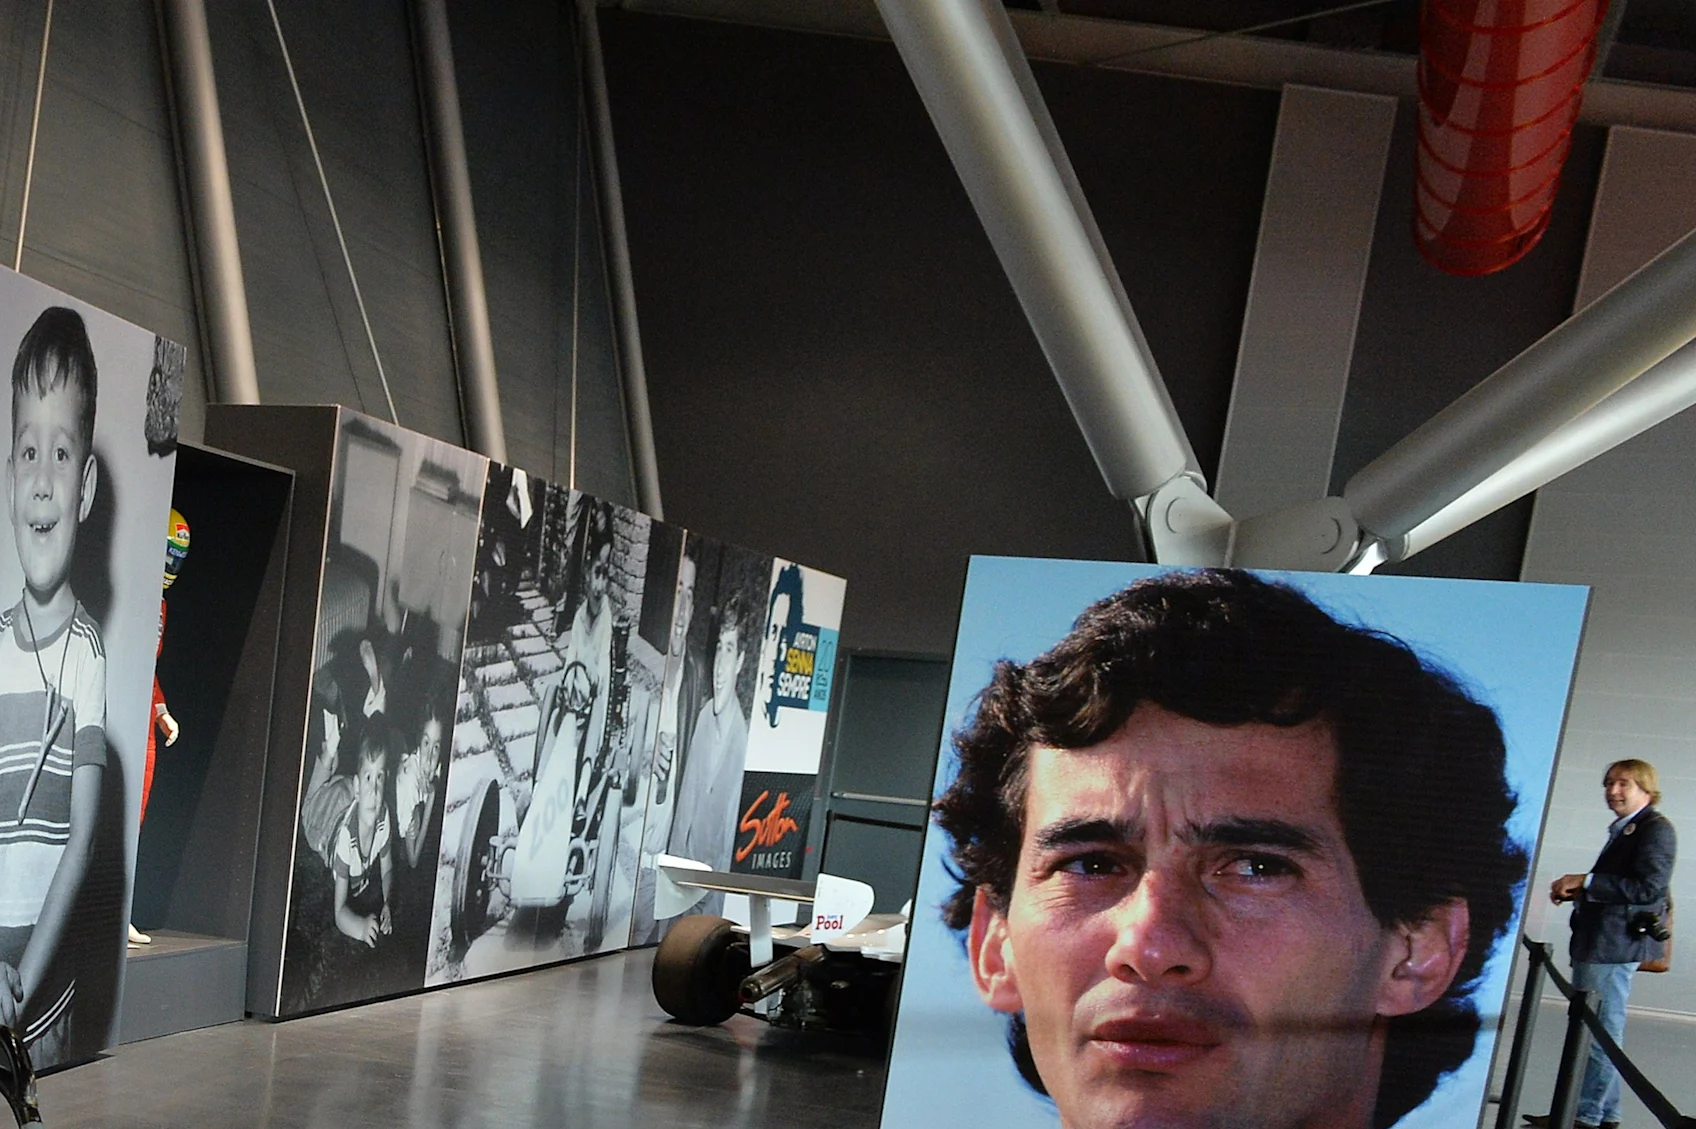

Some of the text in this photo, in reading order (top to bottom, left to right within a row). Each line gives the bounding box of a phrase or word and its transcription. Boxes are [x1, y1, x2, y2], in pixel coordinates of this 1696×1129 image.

[786, 647, 814, 675] SENNA
[777, 671, 811, 700] SEMPRE
[735, 790, 799, 863] Sutton
[751, 851, 792, 870] IMAGES
[815, 915, 844, 931] Pool
